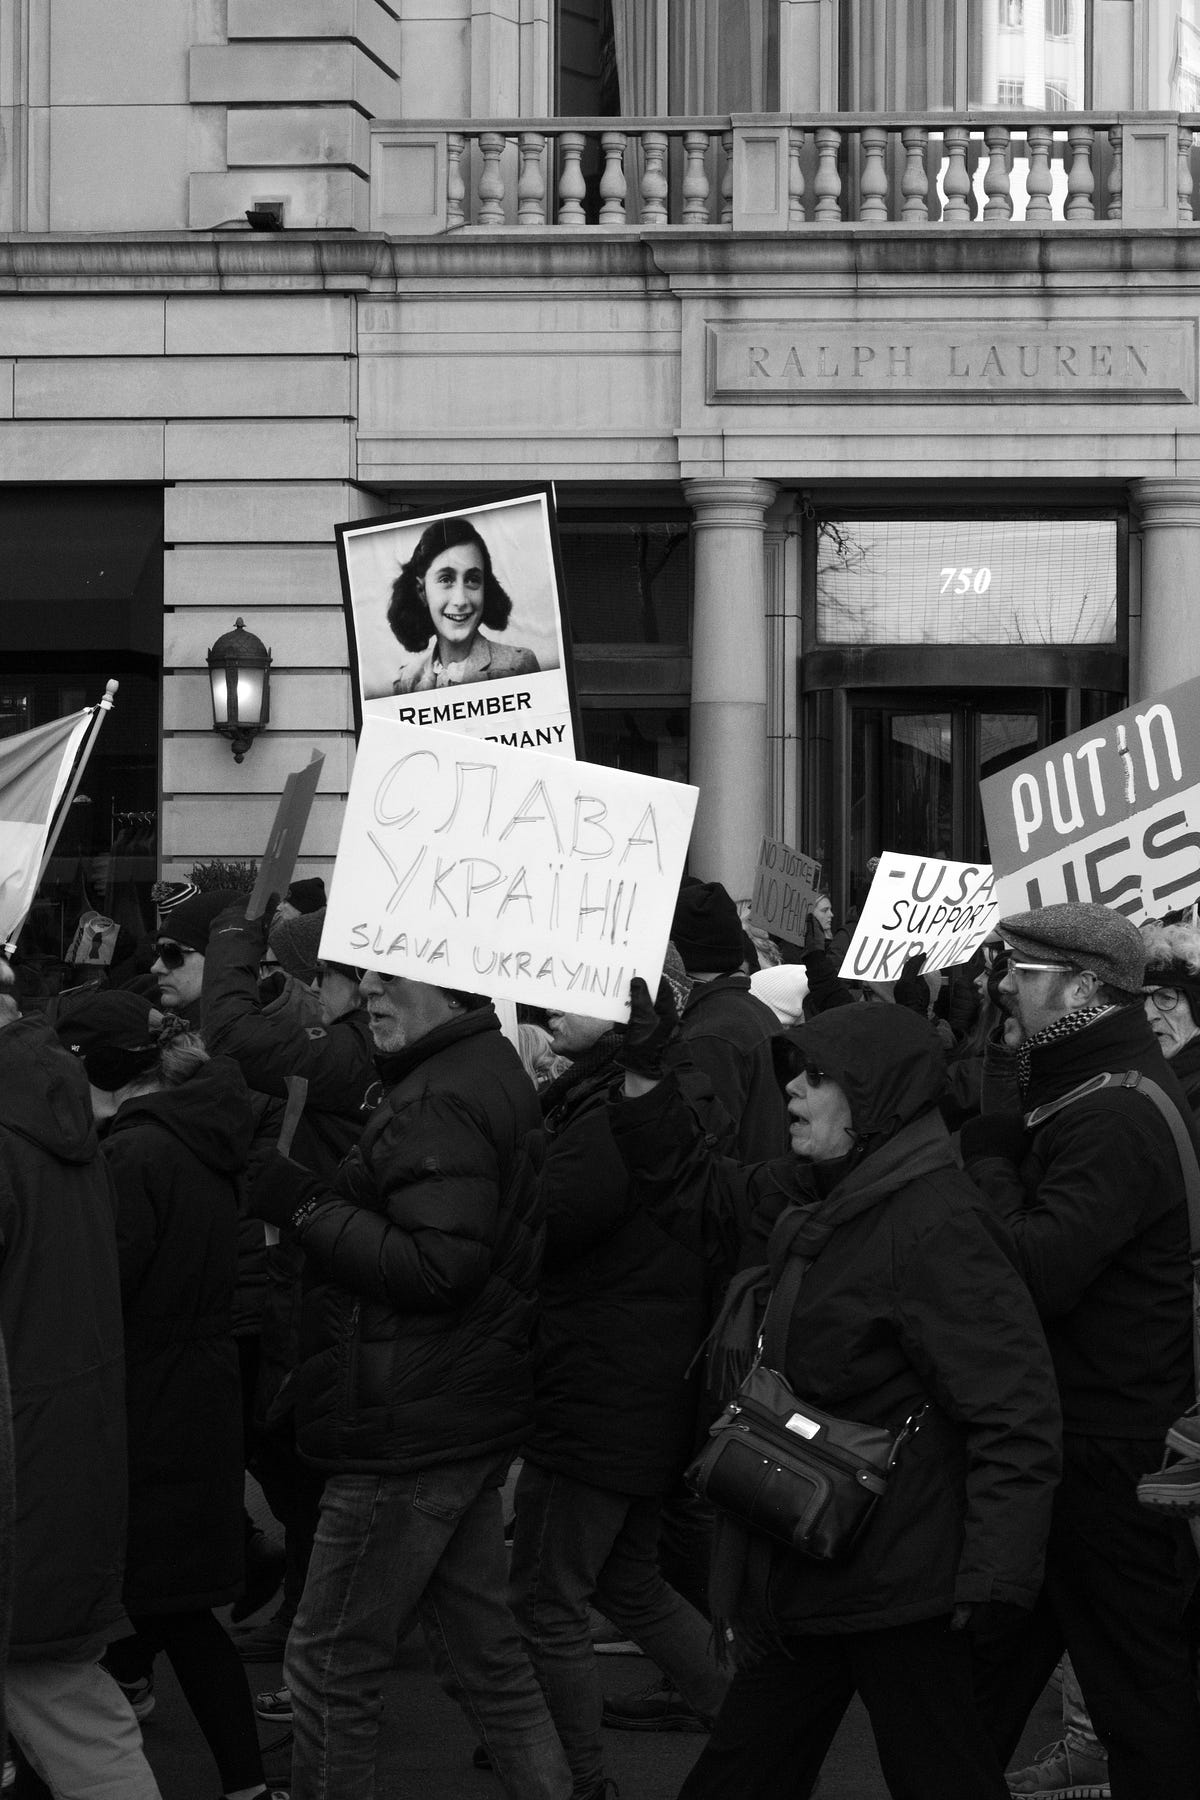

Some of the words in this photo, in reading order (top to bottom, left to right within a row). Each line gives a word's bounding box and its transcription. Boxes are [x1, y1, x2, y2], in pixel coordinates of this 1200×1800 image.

[747, 345, 914, 378] RALPH
[947, 344, 1152, 378] LAUREN
[939, 567, 992, 595] 750
[399, 692, 532, 726] REMEMBER
[484, 724, 567, 749] MANY
[374, 750, 664, 876] СЛАВА
[760, 839, 777, 869] NO
[779, 848, 813, 884] JUSTICE
[756, 873, 779, 923] NO
[882, 900, 998, 936] SUPPORT
[350, 923, 451, 966] SLAVA
